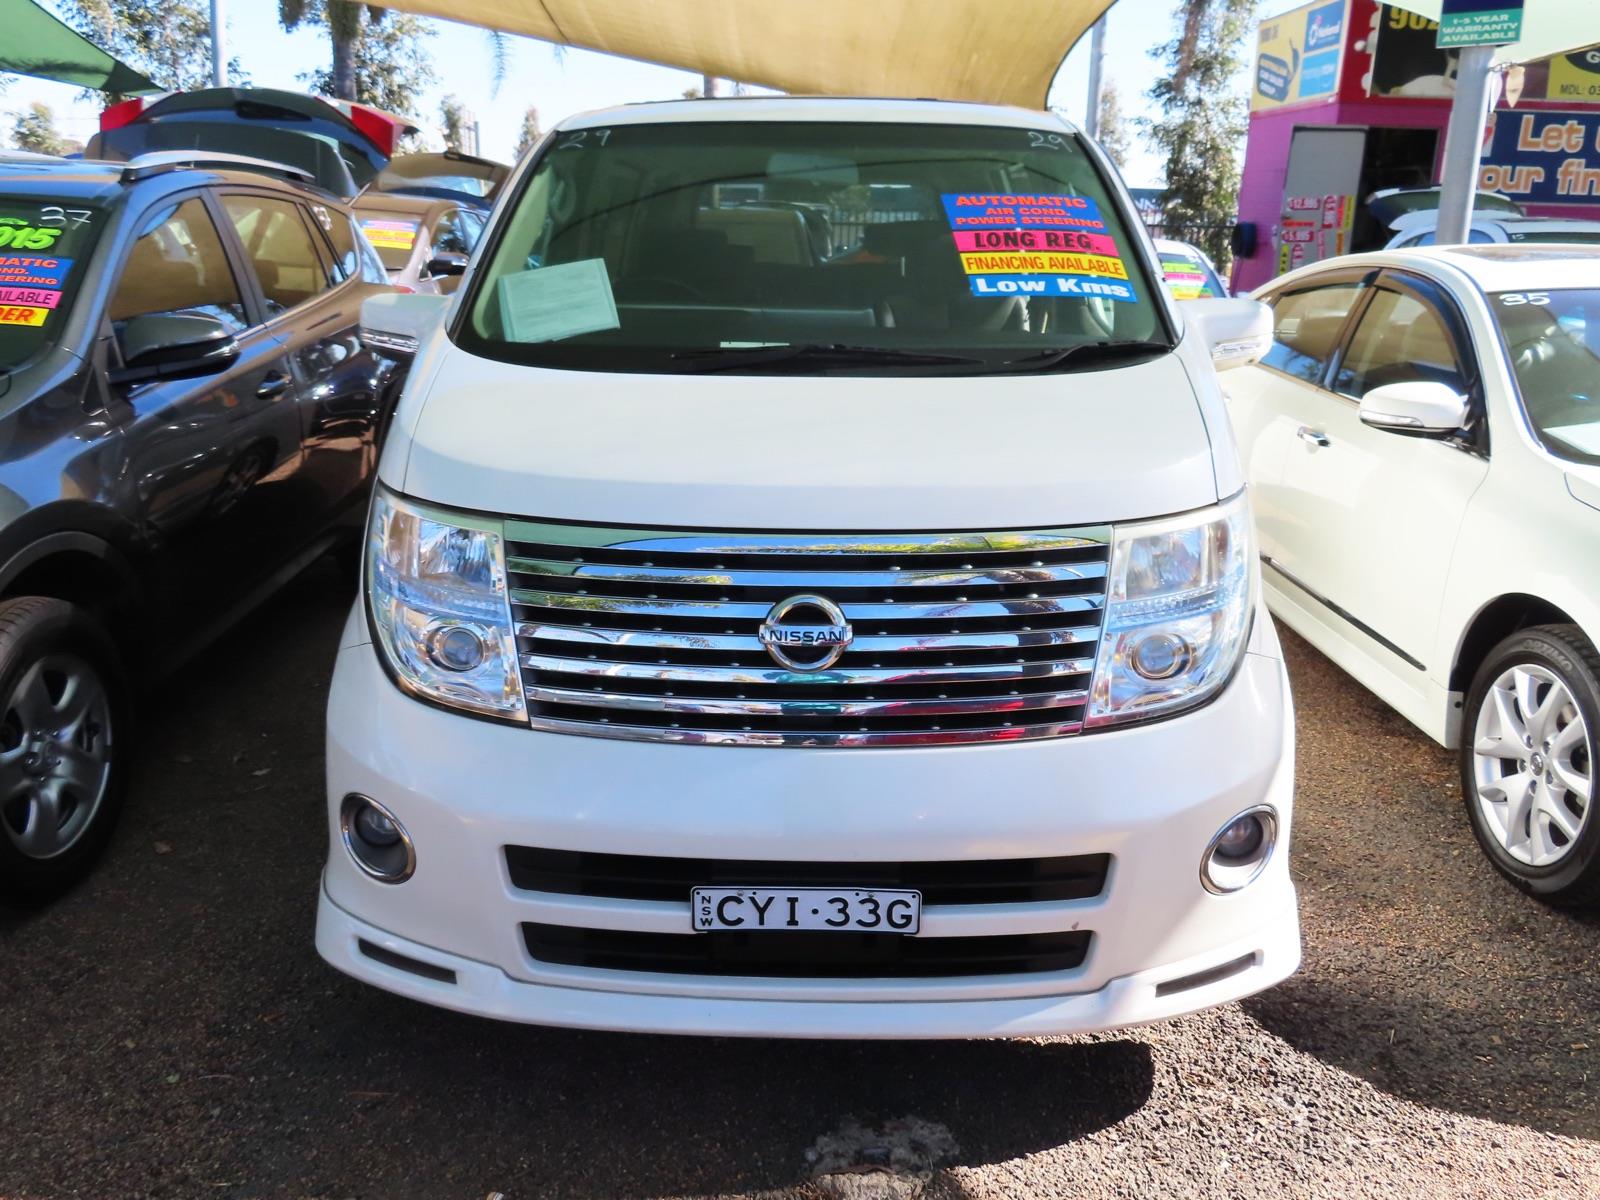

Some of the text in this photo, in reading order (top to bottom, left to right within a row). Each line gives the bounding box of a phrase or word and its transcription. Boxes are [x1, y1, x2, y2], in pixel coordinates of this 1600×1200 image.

[1474, 14, 1509, 23] YEAR
[1442, 22, 1519, 33] WARRANTY
[1441, 31, 1516, 42] AVAILABLE
[1517, 114, 1586, 153] Let
[1027, 130, 1073, 153] 29
[955, 195, 1087, 209] AUTOMATIC
[38, 206, 93, 231] 37
[986, 207, 1071, 217] AIR COND.
[955, 216, 1104, 229] POWER STEERING
[974, 232, 1101, 250] LONG REG.
[965, 256, 1125, 276] FINANCING AVAILABLE
[975, 278, 1131, 298] Low Kms
[1499, 292, 1550, 306] 35
[769, 630, 841, 642] NISSAN
